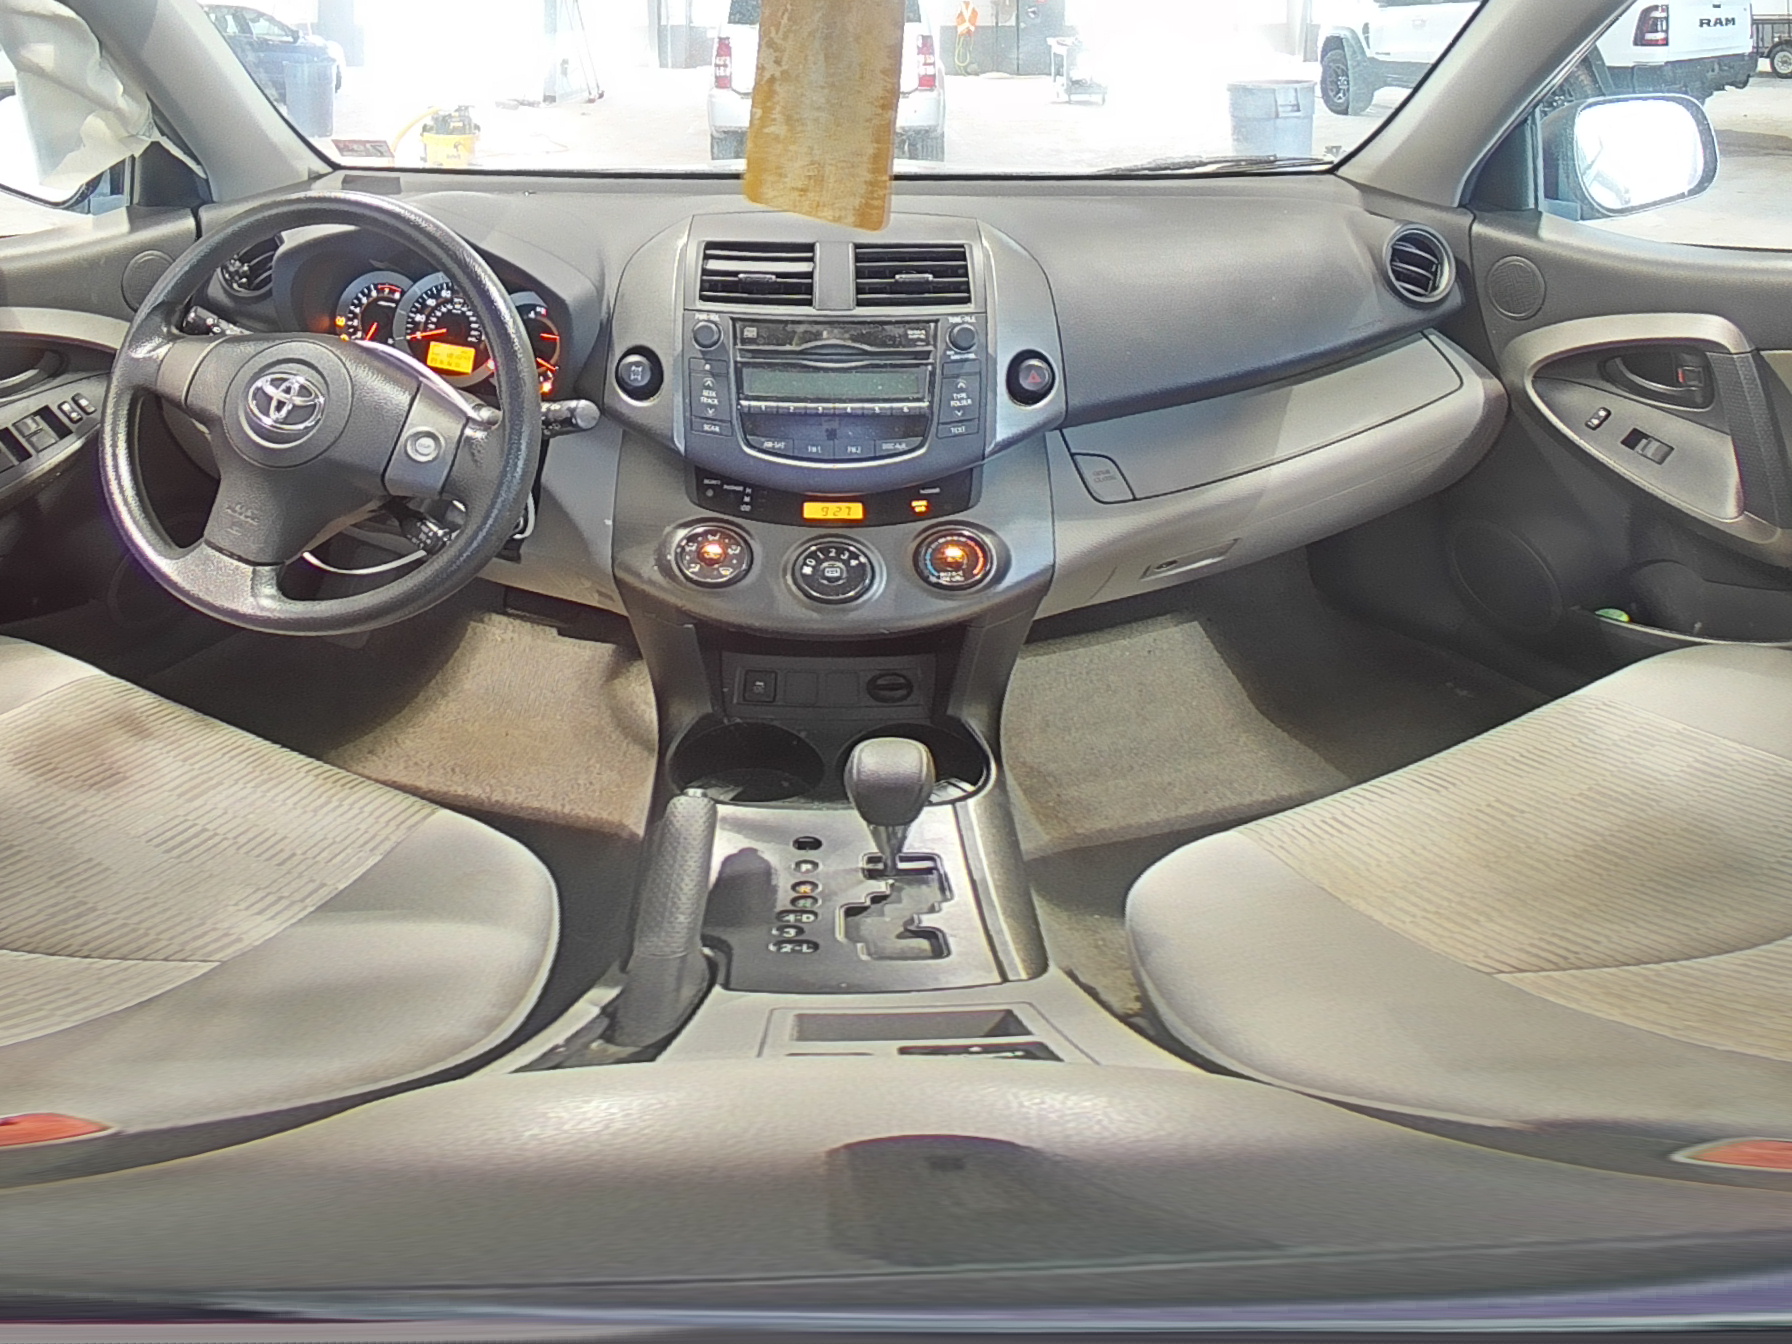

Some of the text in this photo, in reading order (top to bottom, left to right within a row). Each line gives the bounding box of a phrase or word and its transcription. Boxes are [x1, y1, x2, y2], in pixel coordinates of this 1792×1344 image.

[1698, 17, 1736, 27] RAM
[828, 548, 836, 557] 2
[841, 551, 850, 559] 3
